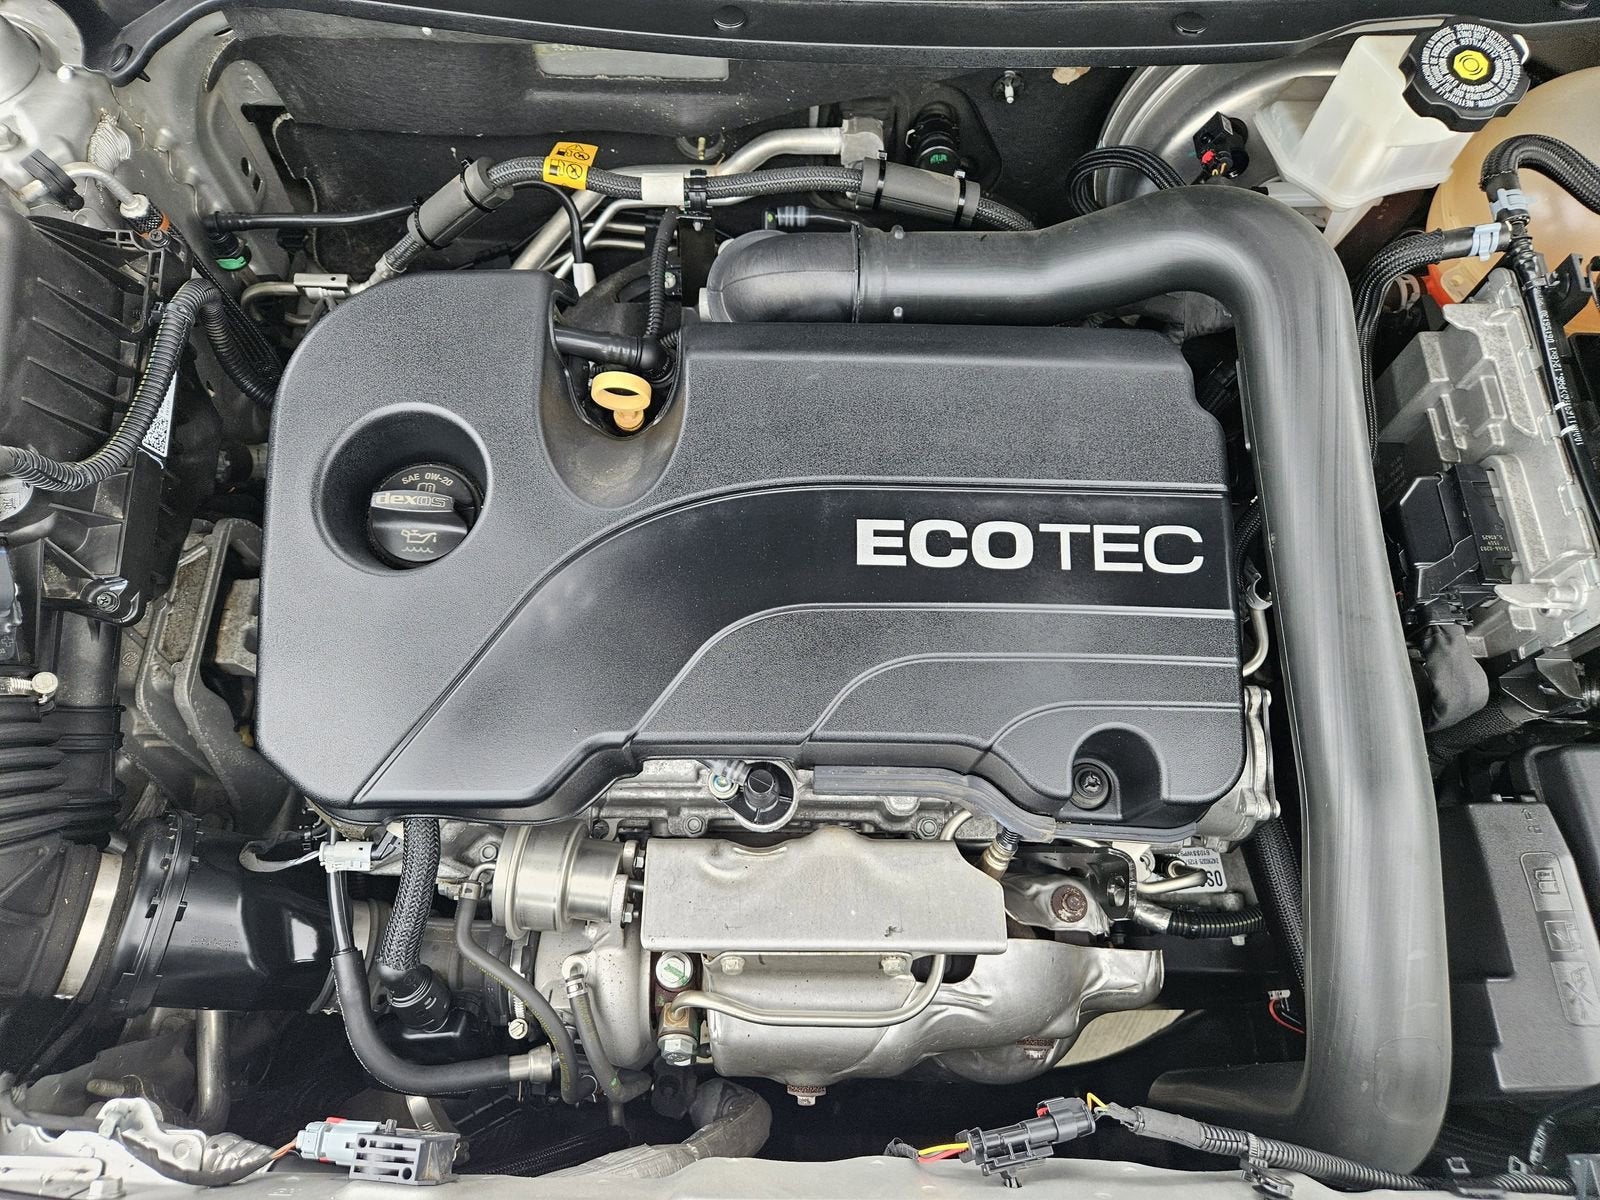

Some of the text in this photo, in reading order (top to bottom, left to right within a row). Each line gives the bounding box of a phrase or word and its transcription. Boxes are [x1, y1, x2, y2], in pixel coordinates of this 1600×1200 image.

[1456, 30, 1472, 39] ONLY
[1472, 31, 1485, 40] USE
[1489, 30, 1510, 48] SEALED
[1459, 38, 1483, 47] FILLER
[1480, 42, 1499, 58] CLEAN
[1508, 49, 1520, 65] FROM
[1435, 88, 1444, 96] LE
[1442, 82, 1452, 91] DU
[402, 472, 454, 487] SAE 0W-20
[375, 493, 446, 508] dexos
[856, 518, 1204, 574] ECOTEC
